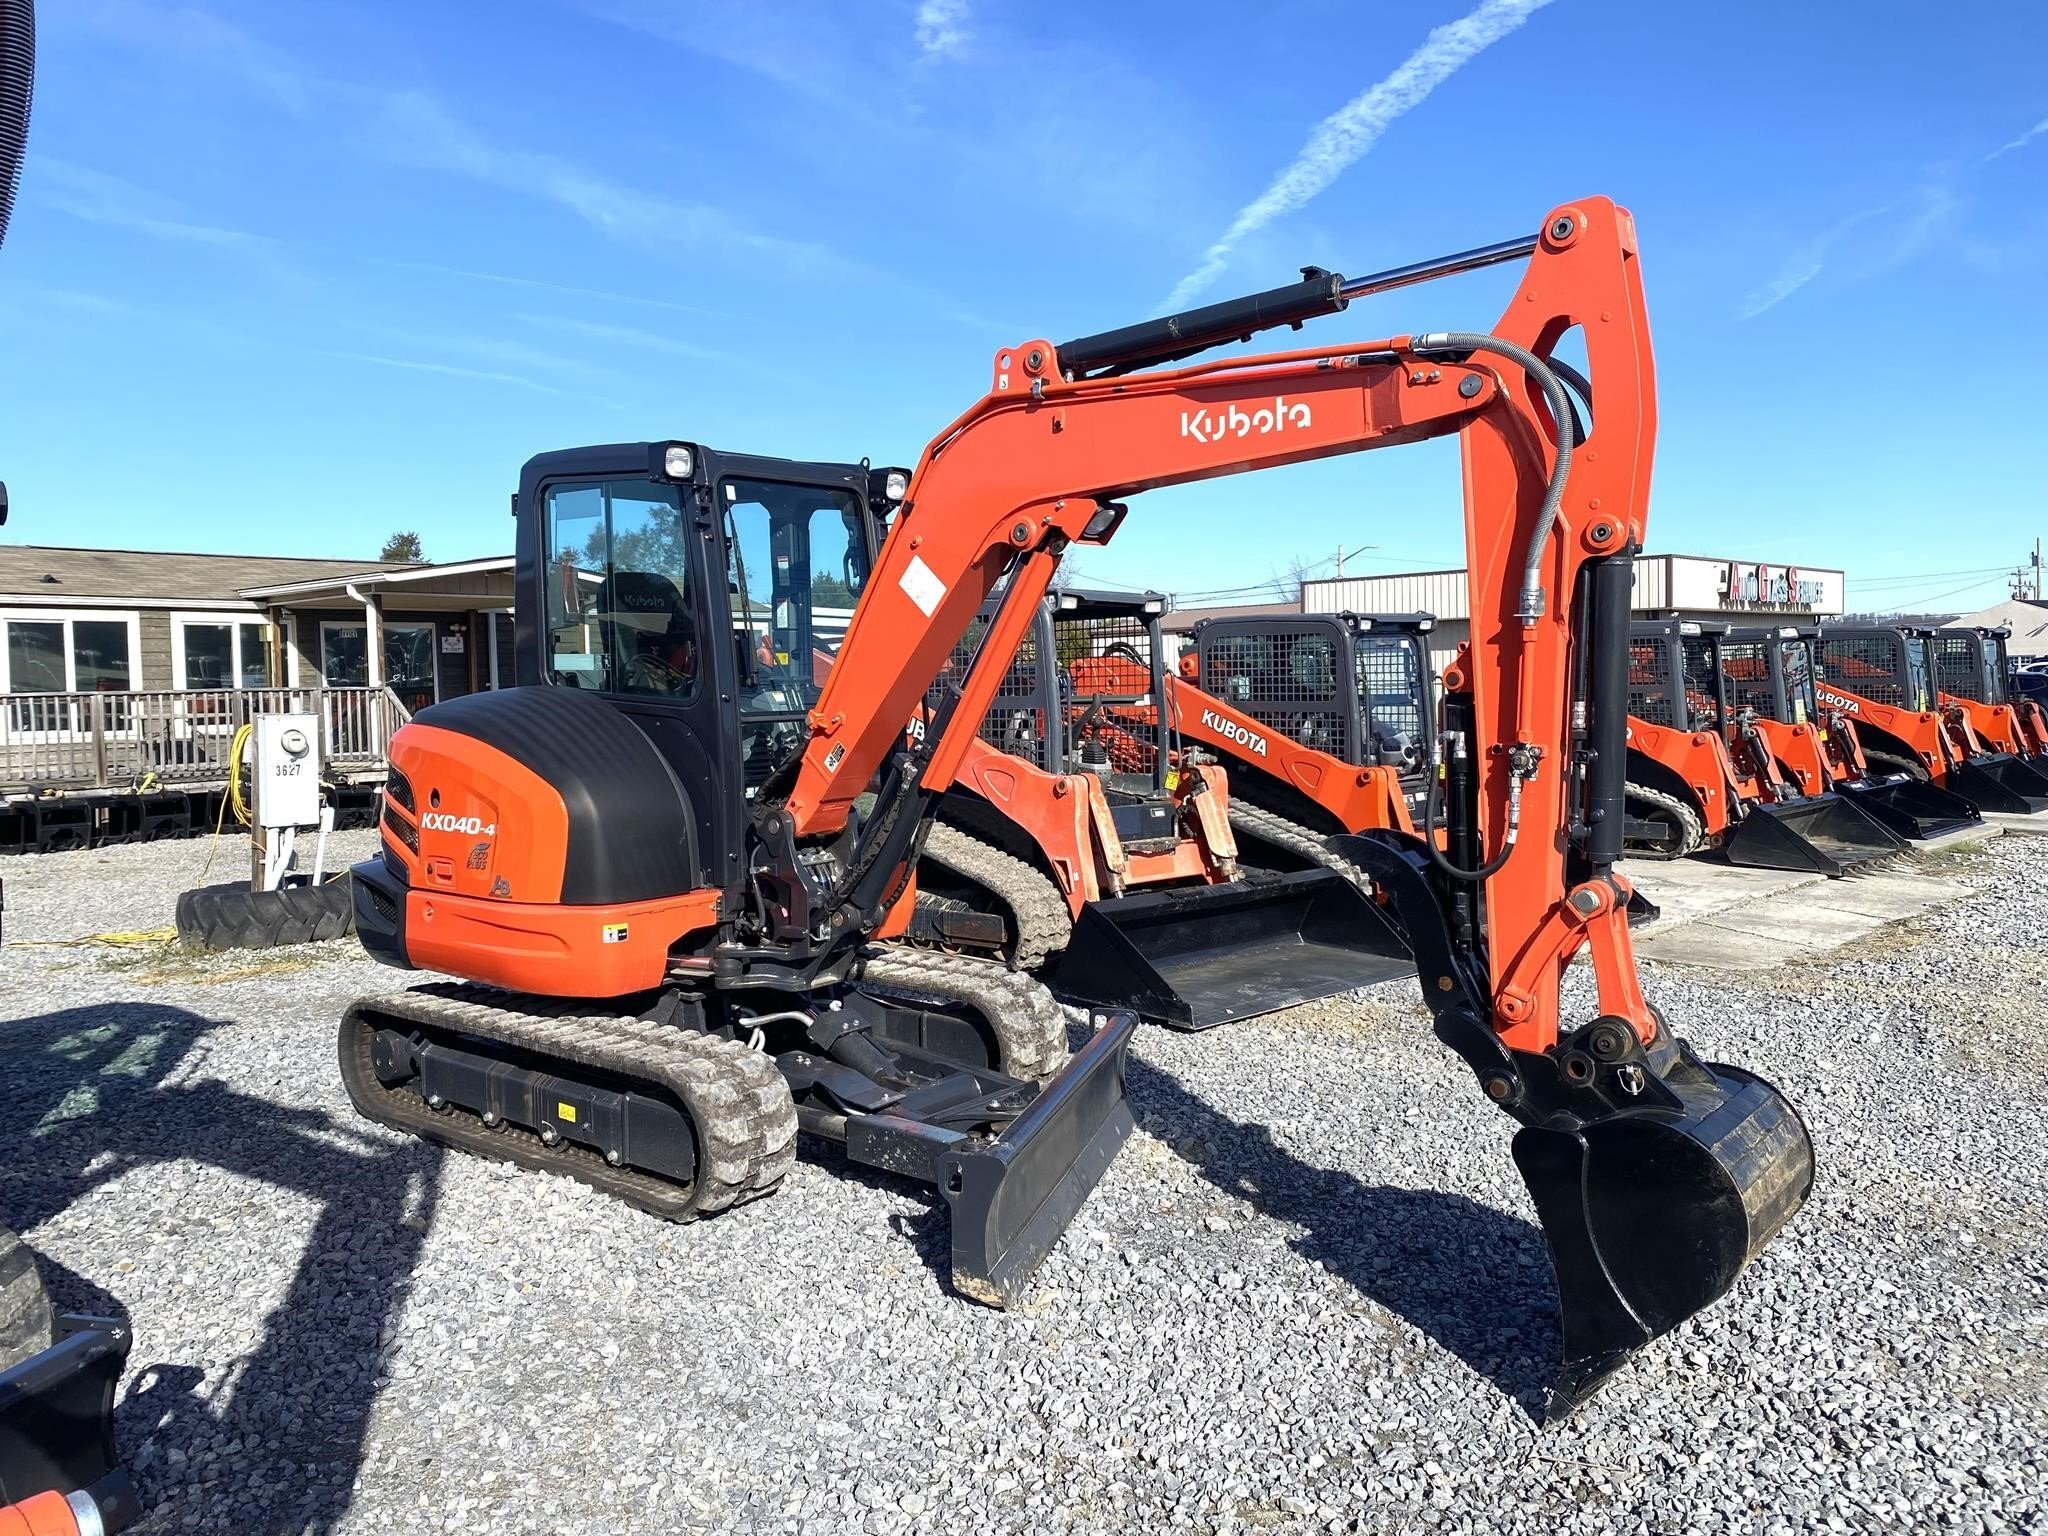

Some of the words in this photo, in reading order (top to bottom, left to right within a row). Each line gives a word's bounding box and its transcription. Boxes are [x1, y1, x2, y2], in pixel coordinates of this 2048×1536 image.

[1181, 396, 1312, 443] Kubota
[624, 594, 665, 607] Kubota
[1201, 708, 1267, 757] KUBOTA
[276, 764, 301, 776] 3627
[421, 812, 496, 836] KX040-4
